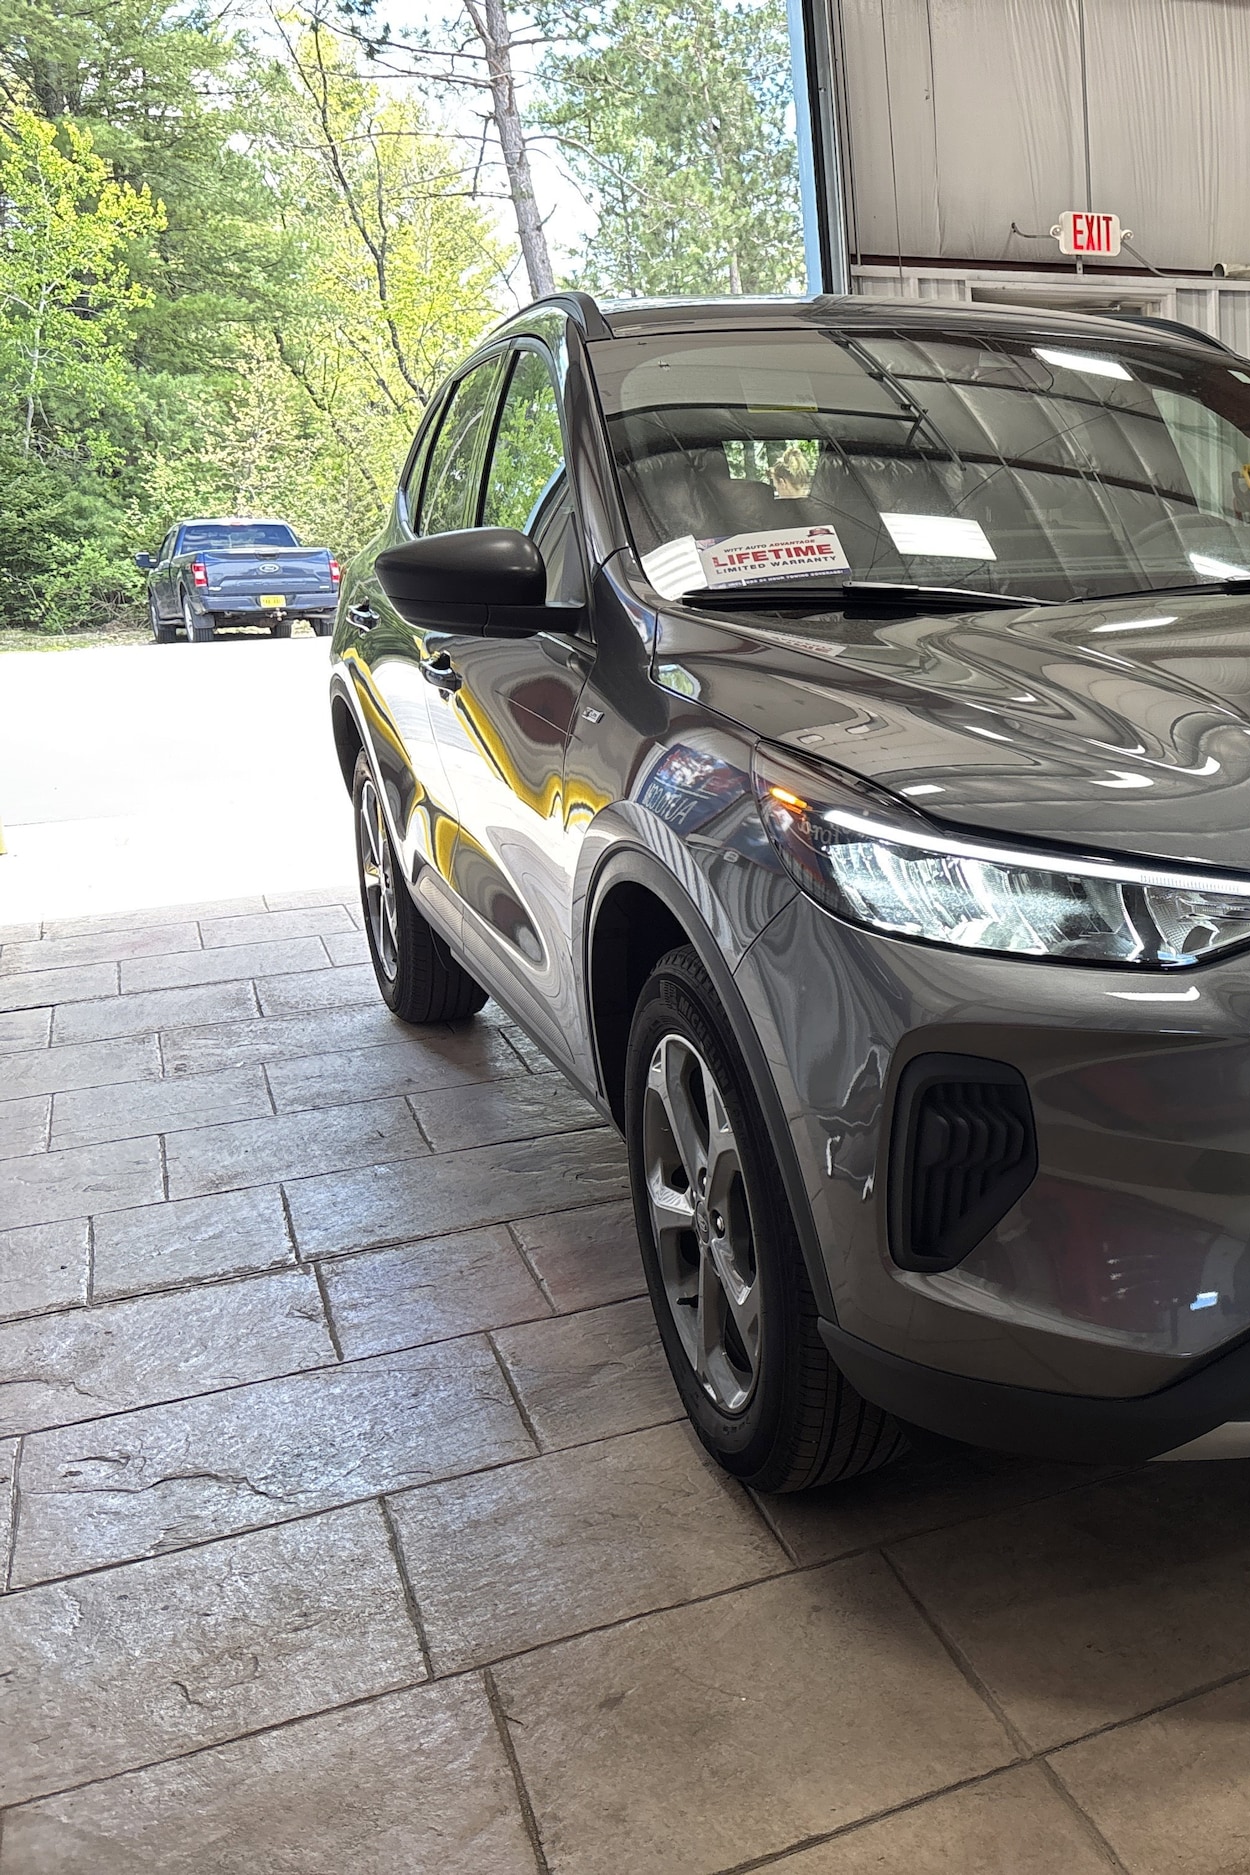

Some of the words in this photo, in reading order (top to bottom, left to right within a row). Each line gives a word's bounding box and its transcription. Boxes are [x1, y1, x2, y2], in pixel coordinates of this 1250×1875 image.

[1072, 213, 1113, 252] EXIT
[769, 539, 815, 547] ADVANTAGE
[712, 544, 833, 567] LIFETIME
[716, 563, 765, 574] LIMITED
[771, 556, 836, 567] WARRANTY
[677, 996, 731, 1094] MICHELIN
